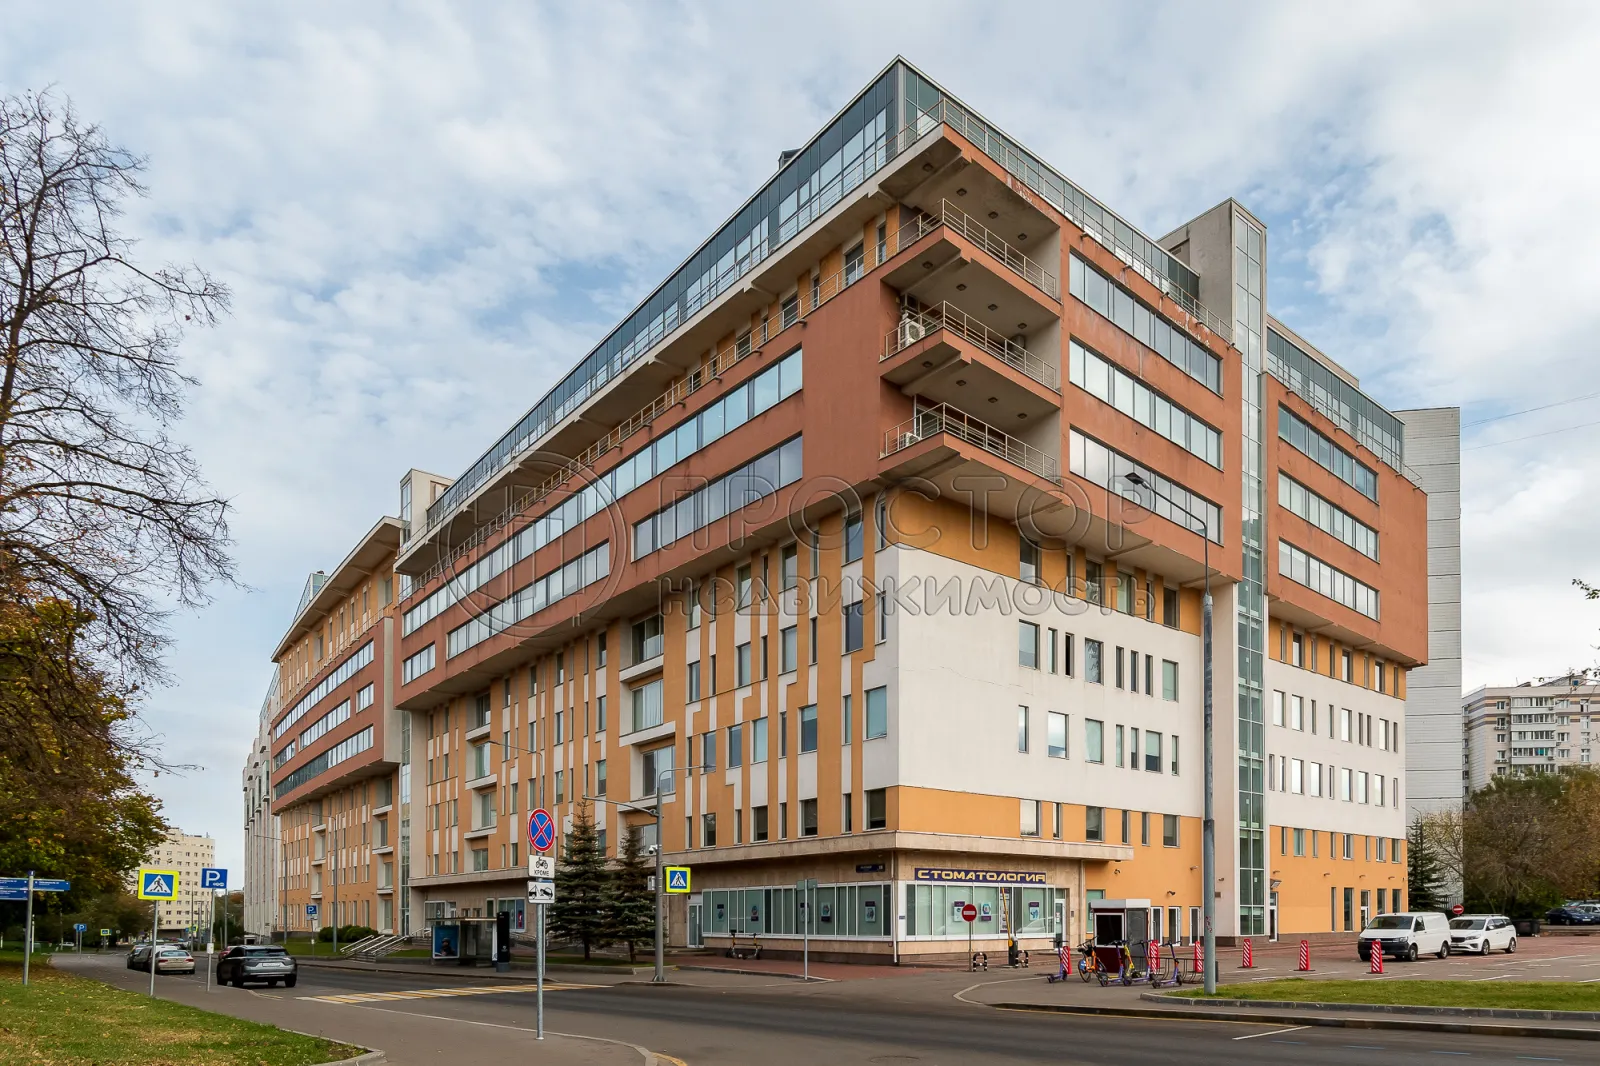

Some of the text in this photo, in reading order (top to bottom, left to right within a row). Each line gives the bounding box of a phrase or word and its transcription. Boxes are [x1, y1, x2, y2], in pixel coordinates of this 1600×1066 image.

[205, 870, 221, 887] P
[533, 869, 550, 877] КРОМЕ
[917, 870, 1046, 882] СТОМАТОЛОГИЯ
